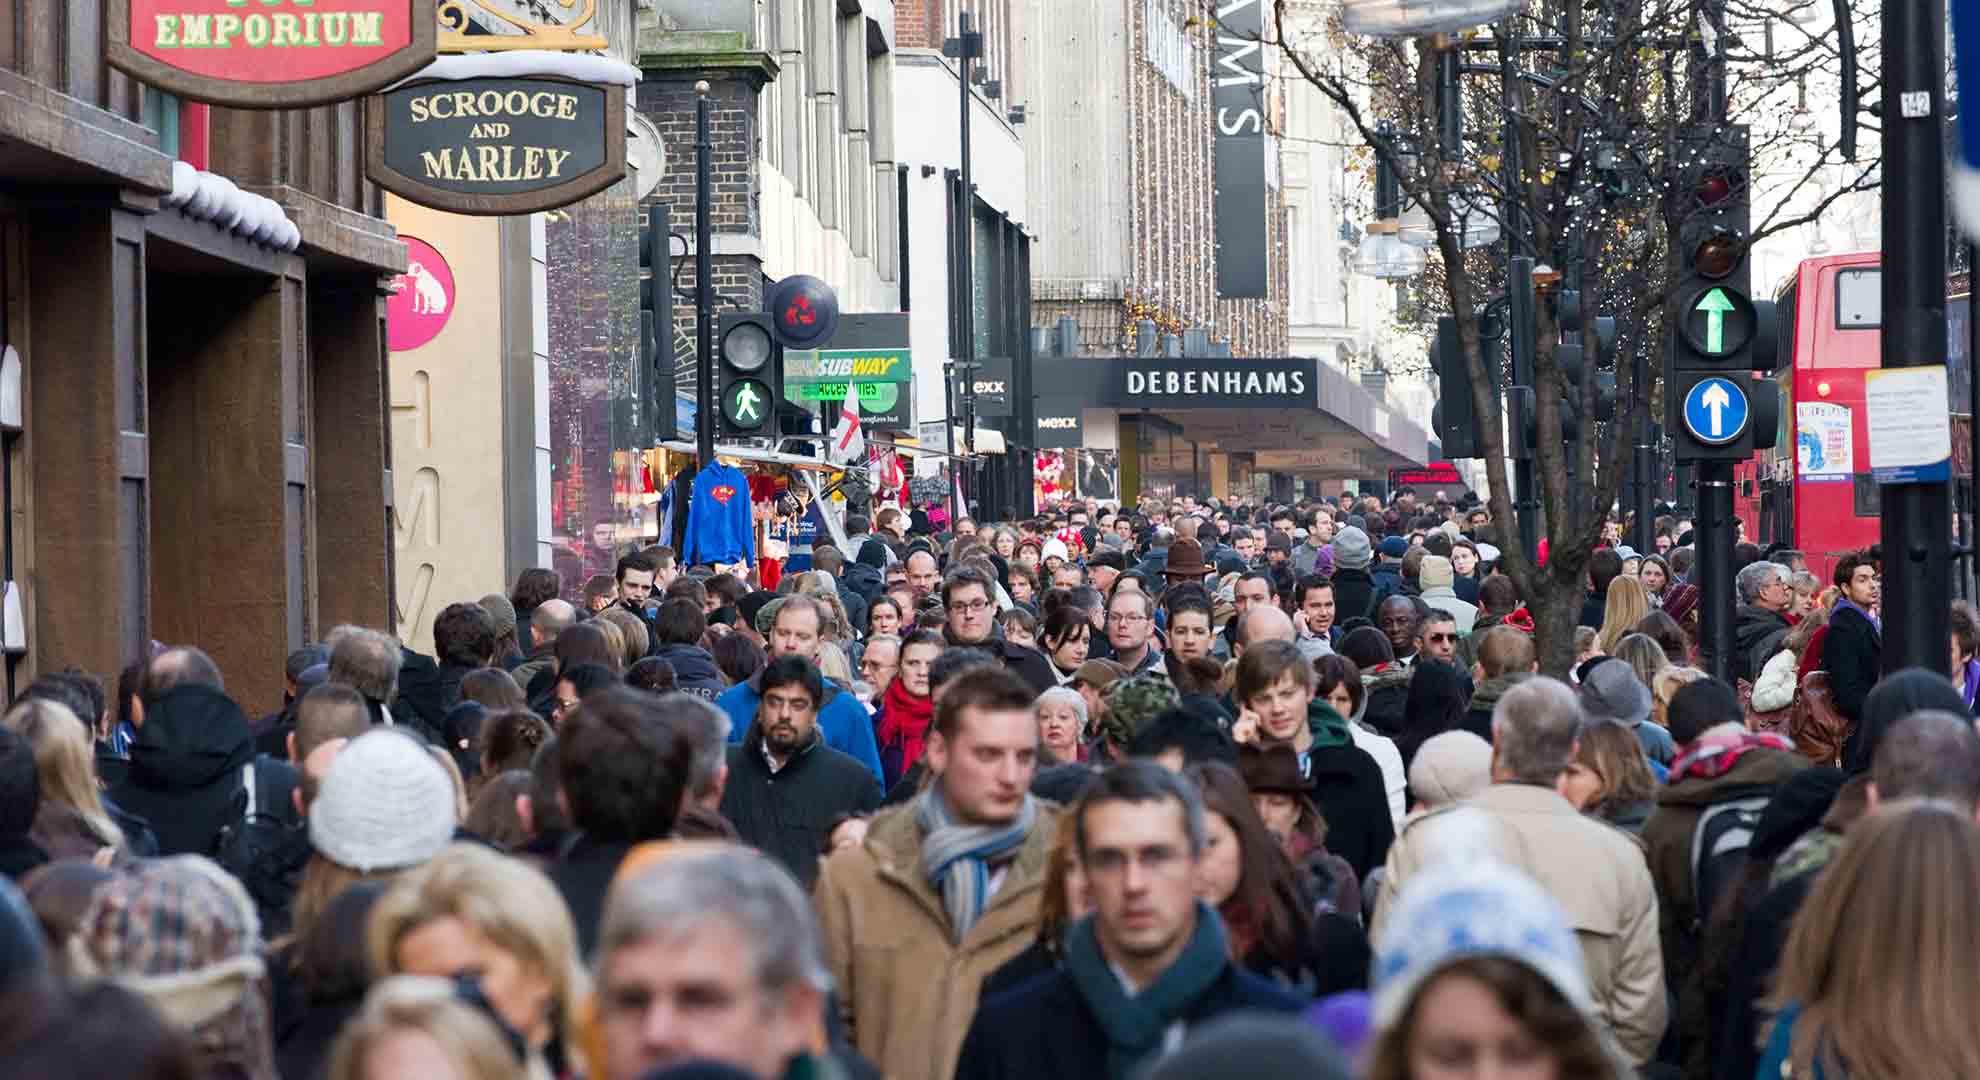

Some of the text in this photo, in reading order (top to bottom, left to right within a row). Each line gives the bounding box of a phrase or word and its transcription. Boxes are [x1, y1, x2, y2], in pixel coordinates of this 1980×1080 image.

[155, 12, 384, 48] EMPORIUM
[410, 90, 578, 122] SCROOGE
[1903, 93, 1928, 115] 142
[469, 123, 511, 138] AND
[420, 145, 571, 181] MARLEY
[818, 357, 898, 376] SUBWAY
[1127, 371, 1305, 394] DEBENHAMS
